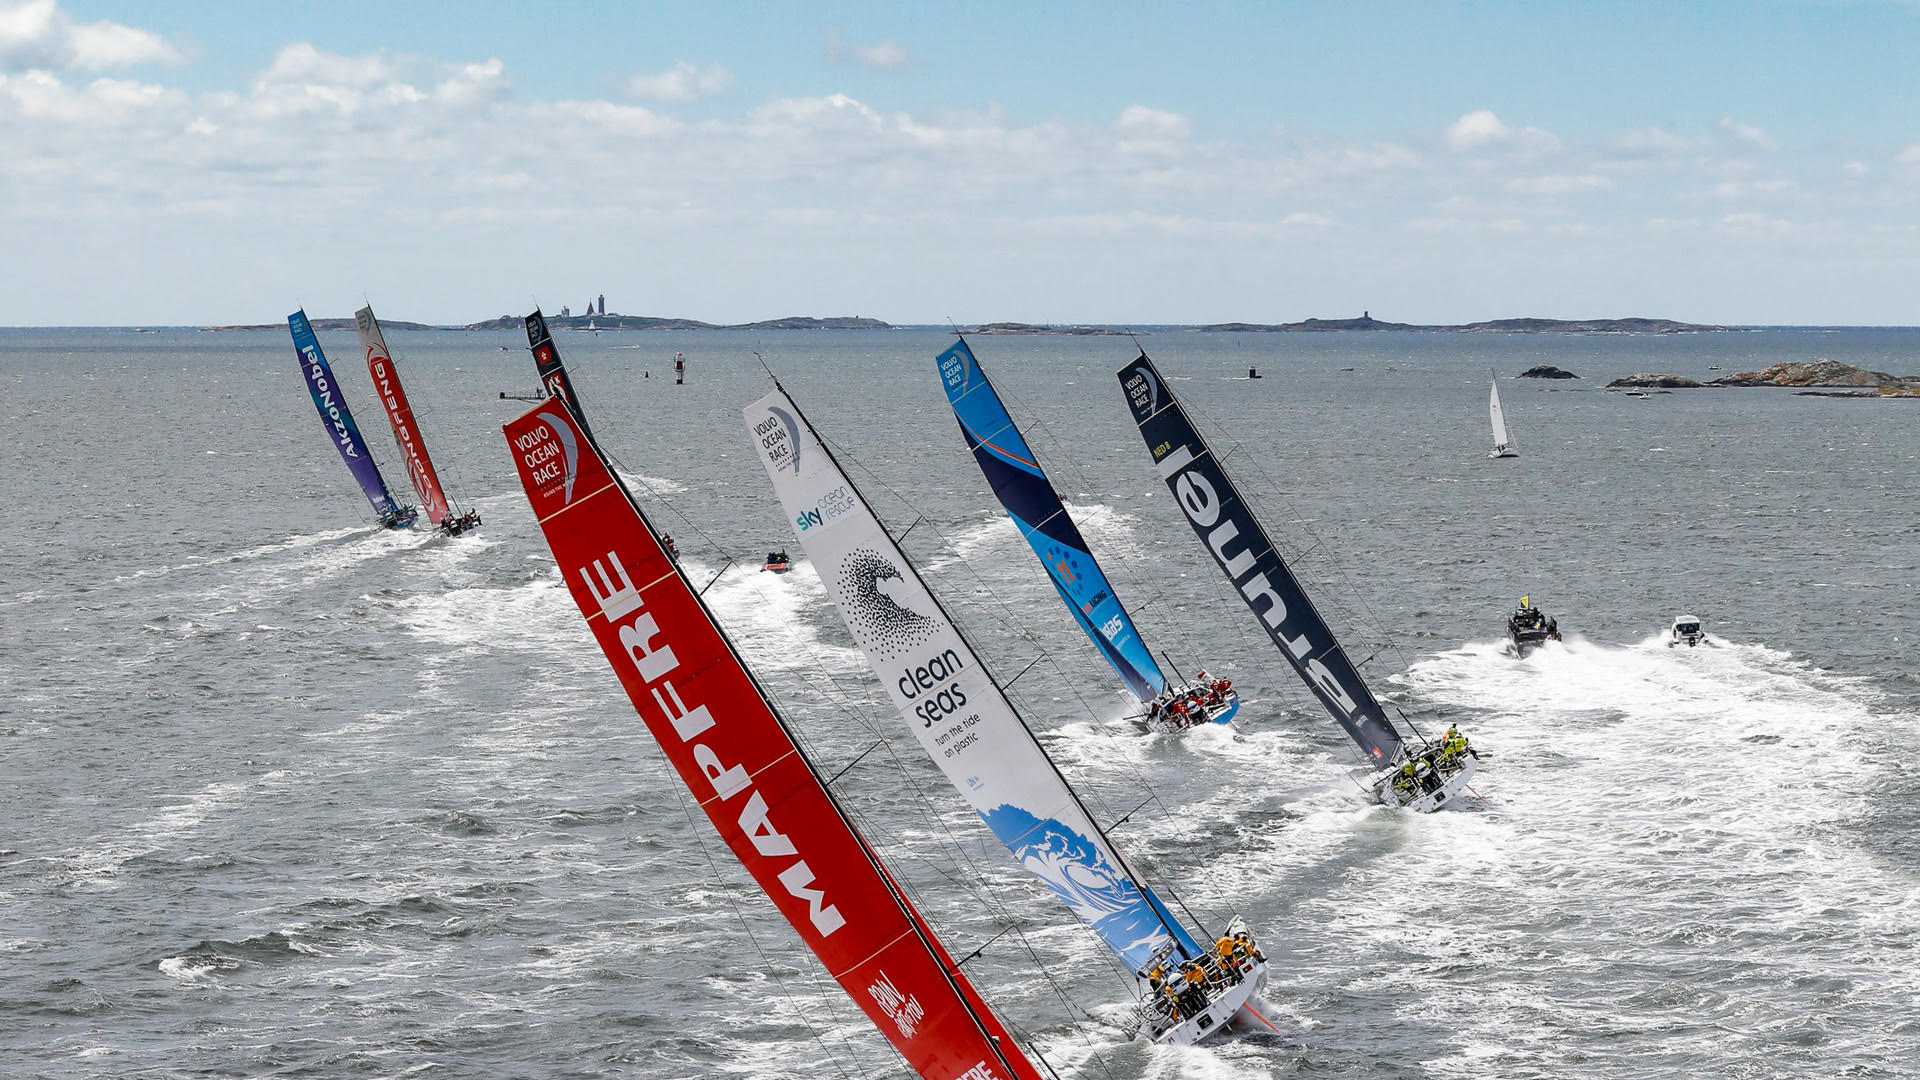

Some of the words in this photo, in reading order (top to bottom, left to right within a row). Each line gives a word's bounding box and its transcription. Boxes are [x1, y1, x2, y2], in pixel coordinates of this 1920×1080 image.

[1124, 374, 1143, 390] VOLVO
[1130, 382, 1149, 399] OCEAN
[1134, 394, 1149, 408] RACE
[374, 362, 433, 489] DONGFENG
[753, 416, 778, 436] VOLVO
[514, 425, 549, 452] VOLVO
[761, 428, 787, 449] OCEAN
[525, 440, 560, 468] OCEAN
[768, 444, 789, 462] RACE
[1153, 444, 1167, 458] NED
[532, 461, 560, 486] RACE
[818, 485, 849, 509] ocean
[825, 496, 856, 520] rescue
[796, 507, 824, 531] sky
[898, 649, 964, 699] clean
[915, 682, 967, 729] seas
[935, 733, 951, 746] turn
[949, 724, 963, 737] the
[962, 714, 981, 729] tide
[579, 550, 847, 938] MAPFRE
[944, 748, 955, 758] on
[953, 732, 978, 755] plastic
